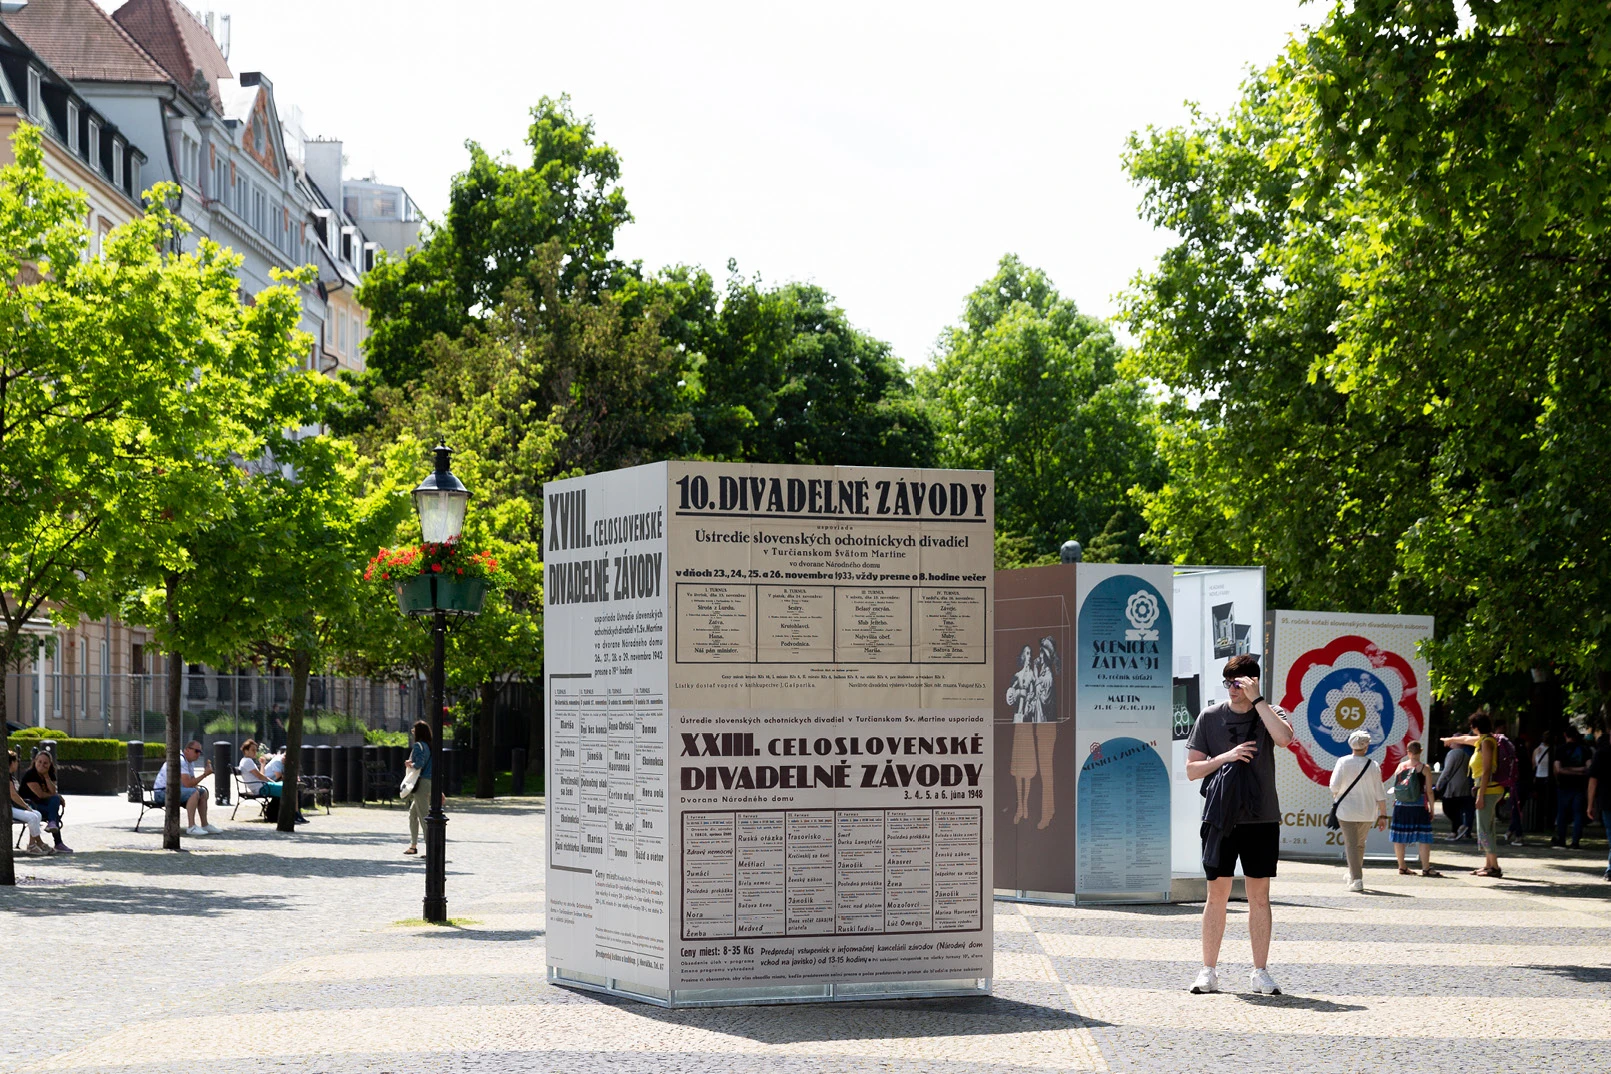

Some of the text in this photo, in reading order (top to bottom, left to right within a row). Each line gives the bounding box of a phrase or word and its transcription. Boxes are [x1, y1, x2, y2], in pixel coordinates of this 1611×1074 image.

[676, 475, 986, 516] 10. DIVADELNÉ ZÁVODY
[549, 489, 662, 551] XVIII. CELOSLOVENSKÉ
[753, 531, 831, 546] slovenských
[772, 547, 832, 557] Turčianskom
[872, 550, 906, 558] Martine
[826, 560, 861, 568] Národného
[549, 549, 662, 606] DIVADELNÉ ZÁVODY
[682, 568, 712, 578] dňoch
[748, 570, 761, 578] 25.
[770, 570, 784, 579] 26.
[784, 570, 833, 580] novembra
[834, 572, 854, 581] 1933,
[856, 572, 878, 581] vždy
[880, 574, 911, 582] presne
[919, 572, 928, 581] 8.
[928, 573, 960, 582] hodine
[962, 574, 986, 582] večer
[636, 608, 662, 620] slovenských
[1330, 620, 1367, 628] slovenských
[1368, 622, 1403, 630] divadelných
[648, 637, 662, 646] domu
[630, 650, 651, 660] novembra
[1340, 706, 1361, 720] 95
[680, 715, 712, 724] Ústredie
[715, 716, 760, 724] slovenských
[948, 716, 984, 724] usporiada
[680, 732, 984, 756] XXIII. CELOSLOVENSKÉ
[680, 759, 984, 790] DIVADELNÉ ZÁVODY
[722, 794, 768, 802] Národného
[942, 790, 948, 799] 6.
[950, 790, 966, 800] júna
[968, 789, 984, 799] 1948
[900, 920, 922, 928] Omega
[680, 948, 696, 958] Ceny
[699, 948, 720, 956] miest:
[760, 947, 795, 956] Predpredaj
[797, 946, 830, 954] vstupeniek
[837, 944, 875, 954] informačnej
